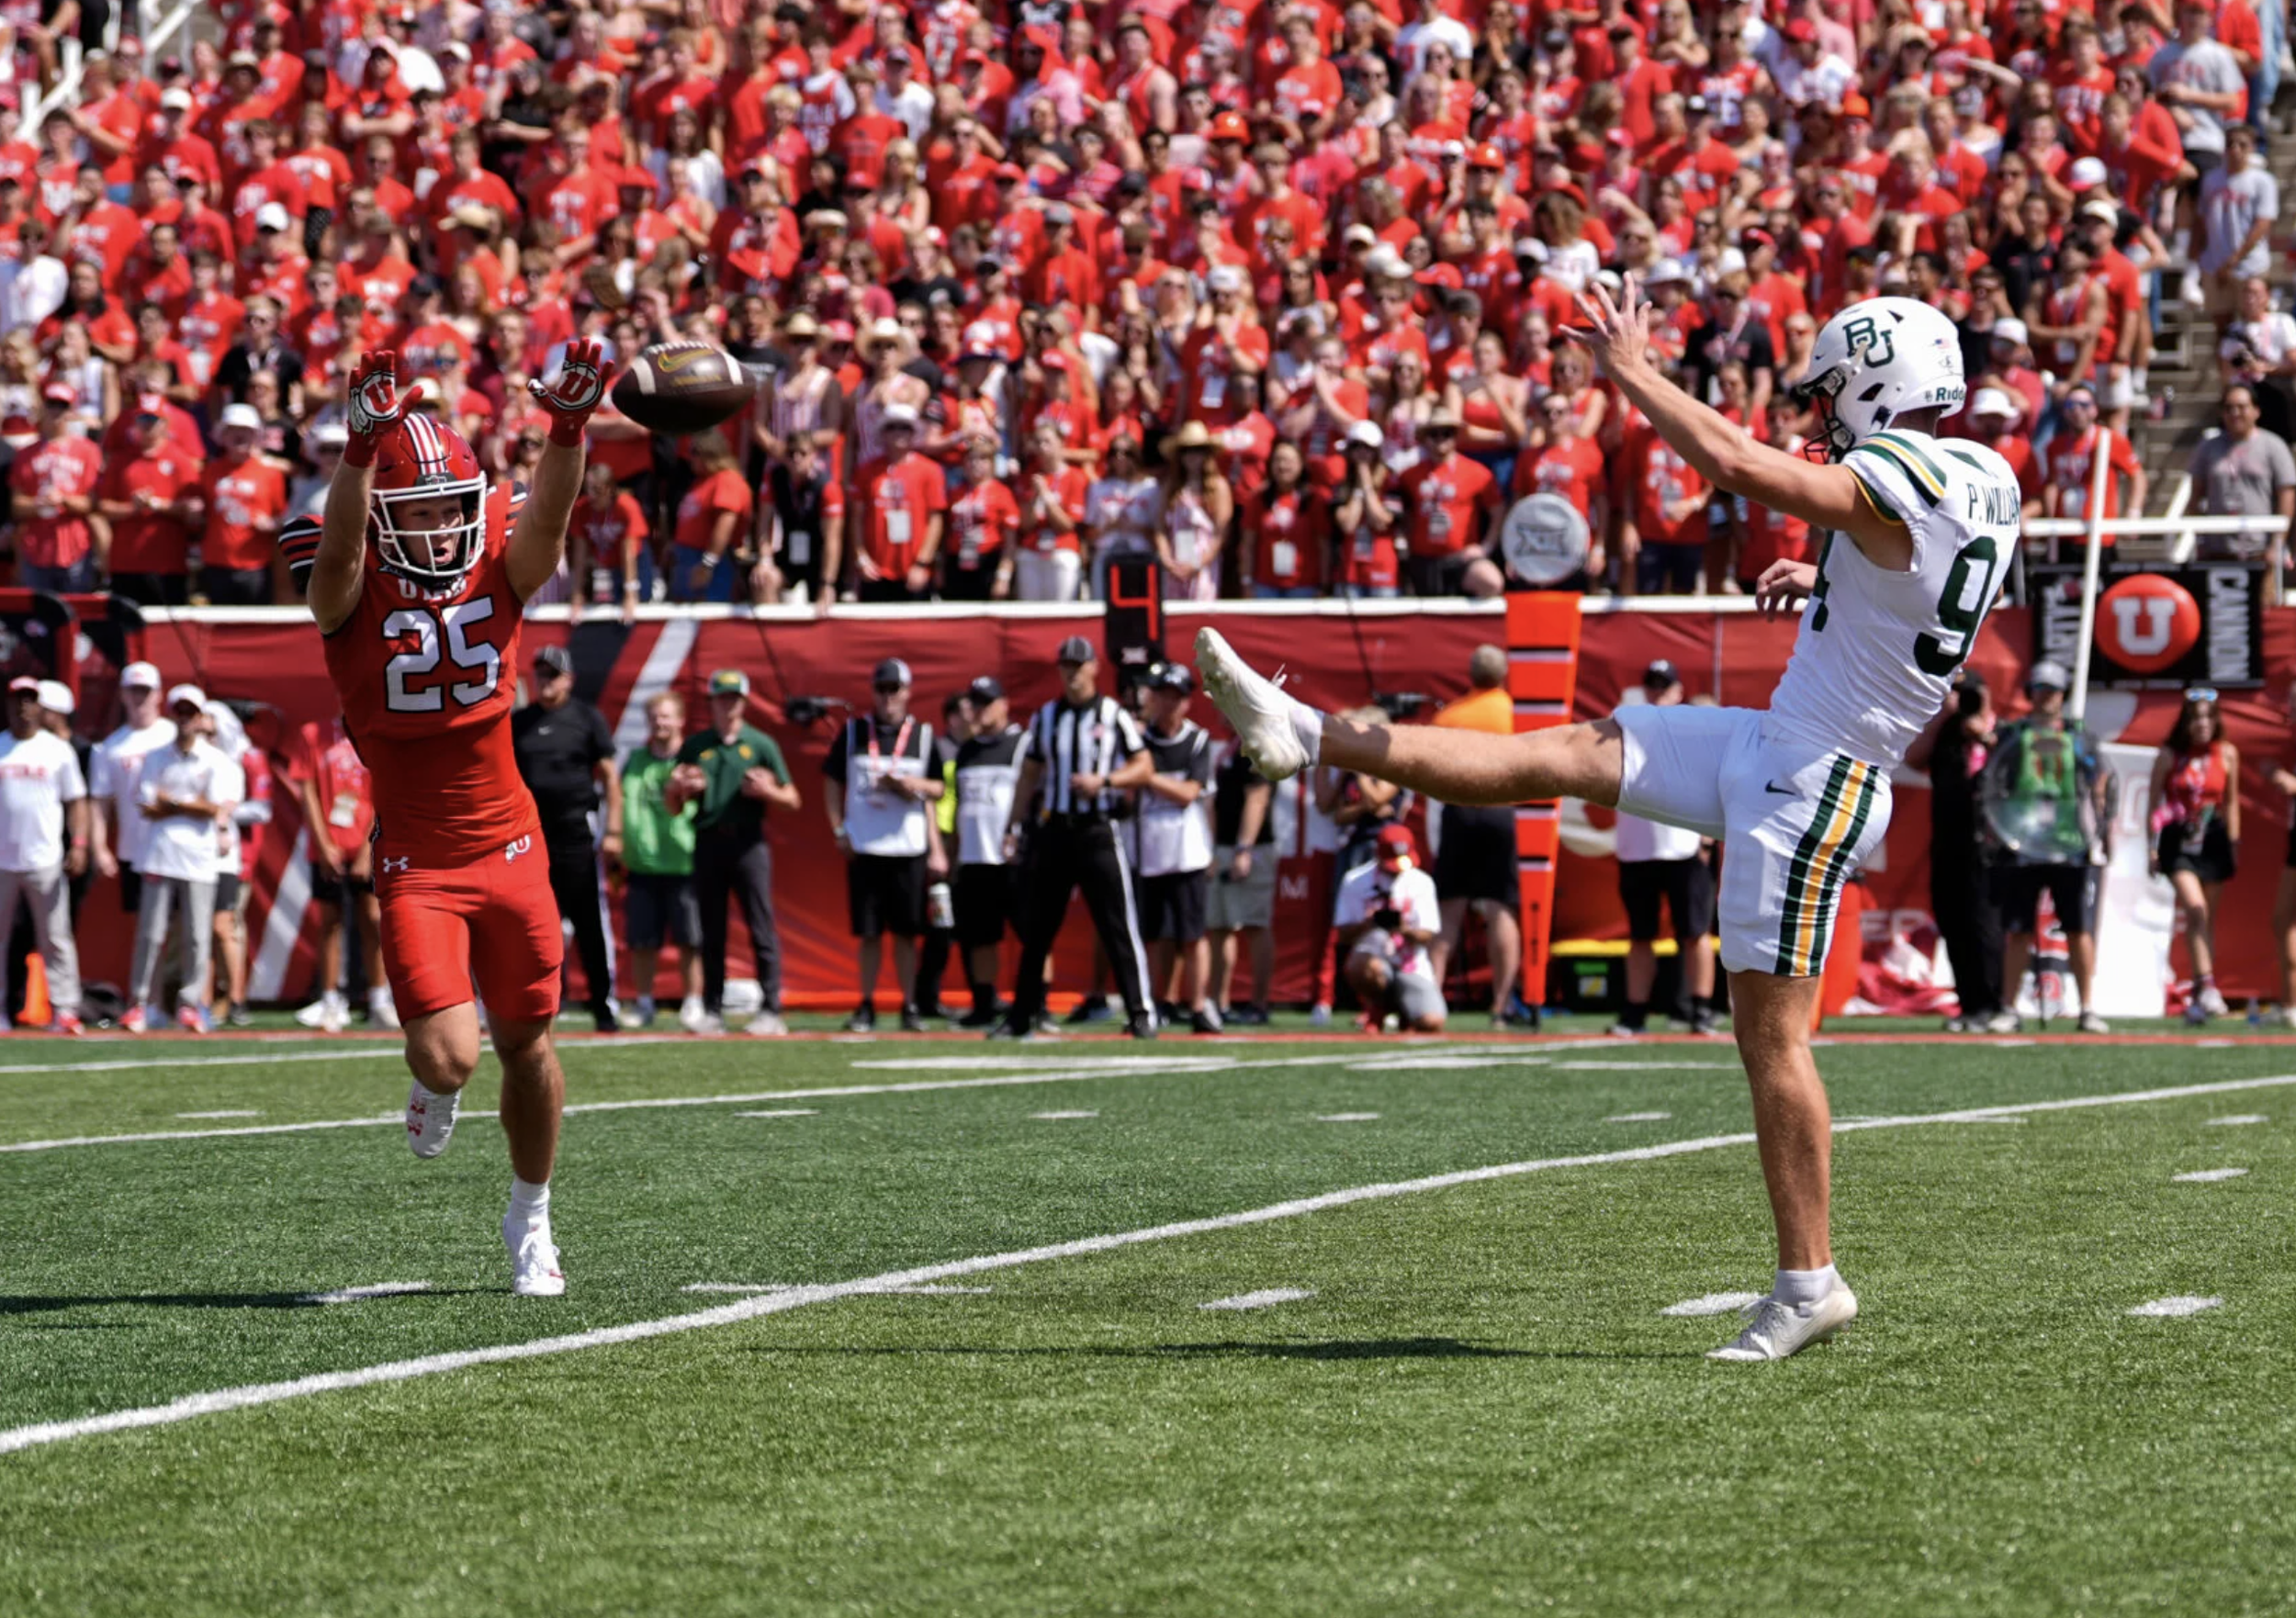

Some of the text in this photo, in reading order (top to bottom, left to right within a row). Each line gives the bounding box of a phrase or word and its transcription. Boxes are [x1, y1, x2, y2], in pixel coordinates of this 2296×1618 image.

[1842, 317, 1894, 367] BU
[1109, 563, 1158, 641] 4
[2111, 597, 2177, 655] U
[2209, 567, 2249, 681] CANNON
[382, 595, 501, 713] 25
